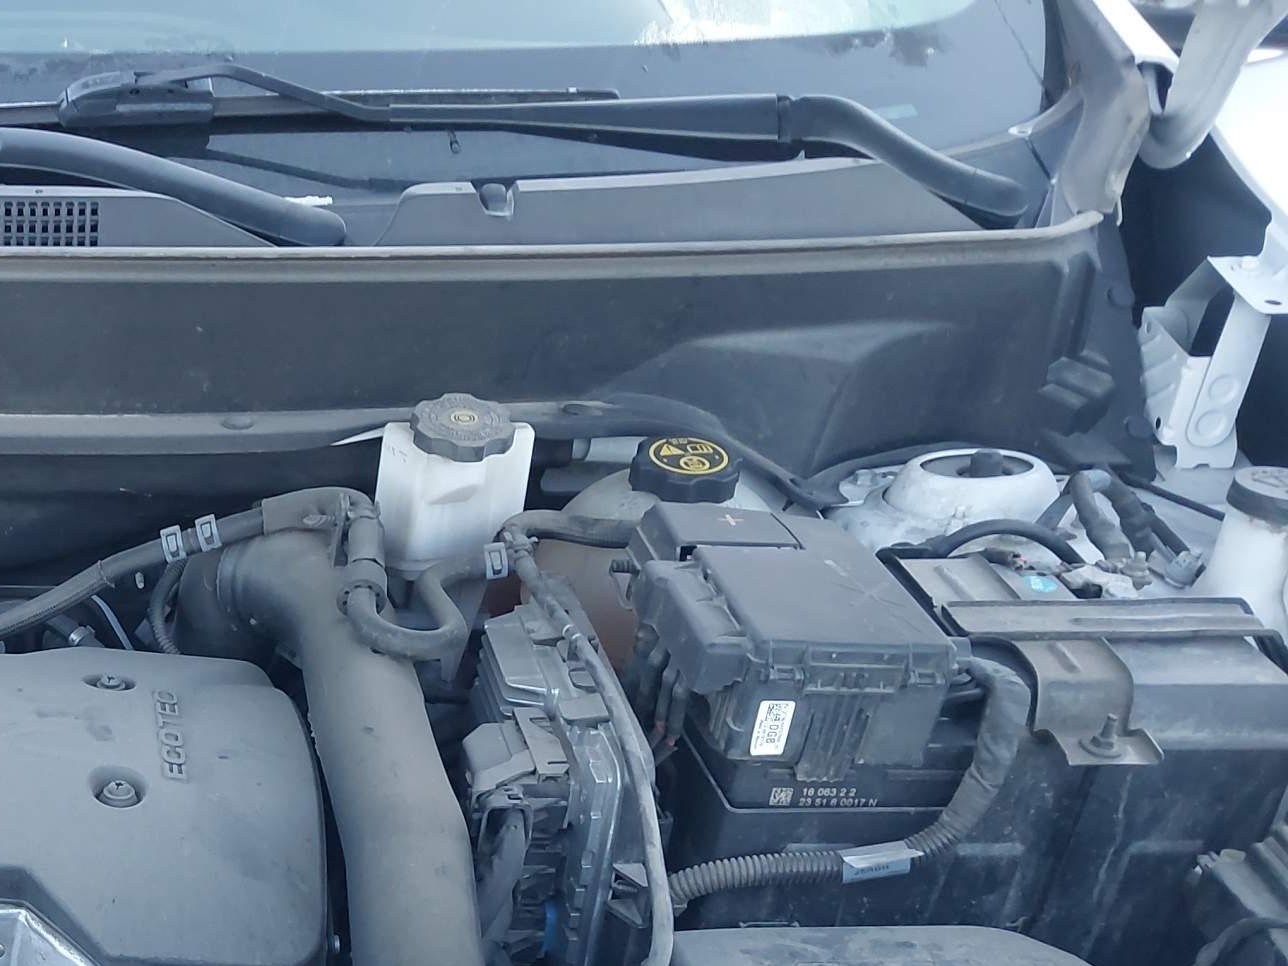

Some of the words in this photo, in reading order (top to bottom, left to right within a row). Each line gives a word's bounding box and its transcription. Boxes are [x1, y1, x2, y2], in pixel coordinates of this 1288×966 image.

[153, 687, 188, 780] ECOTEC
[839, 787, 848, 797] 2
[848, 787, 857, 797] 2
[868, 798, 878, 807] N
